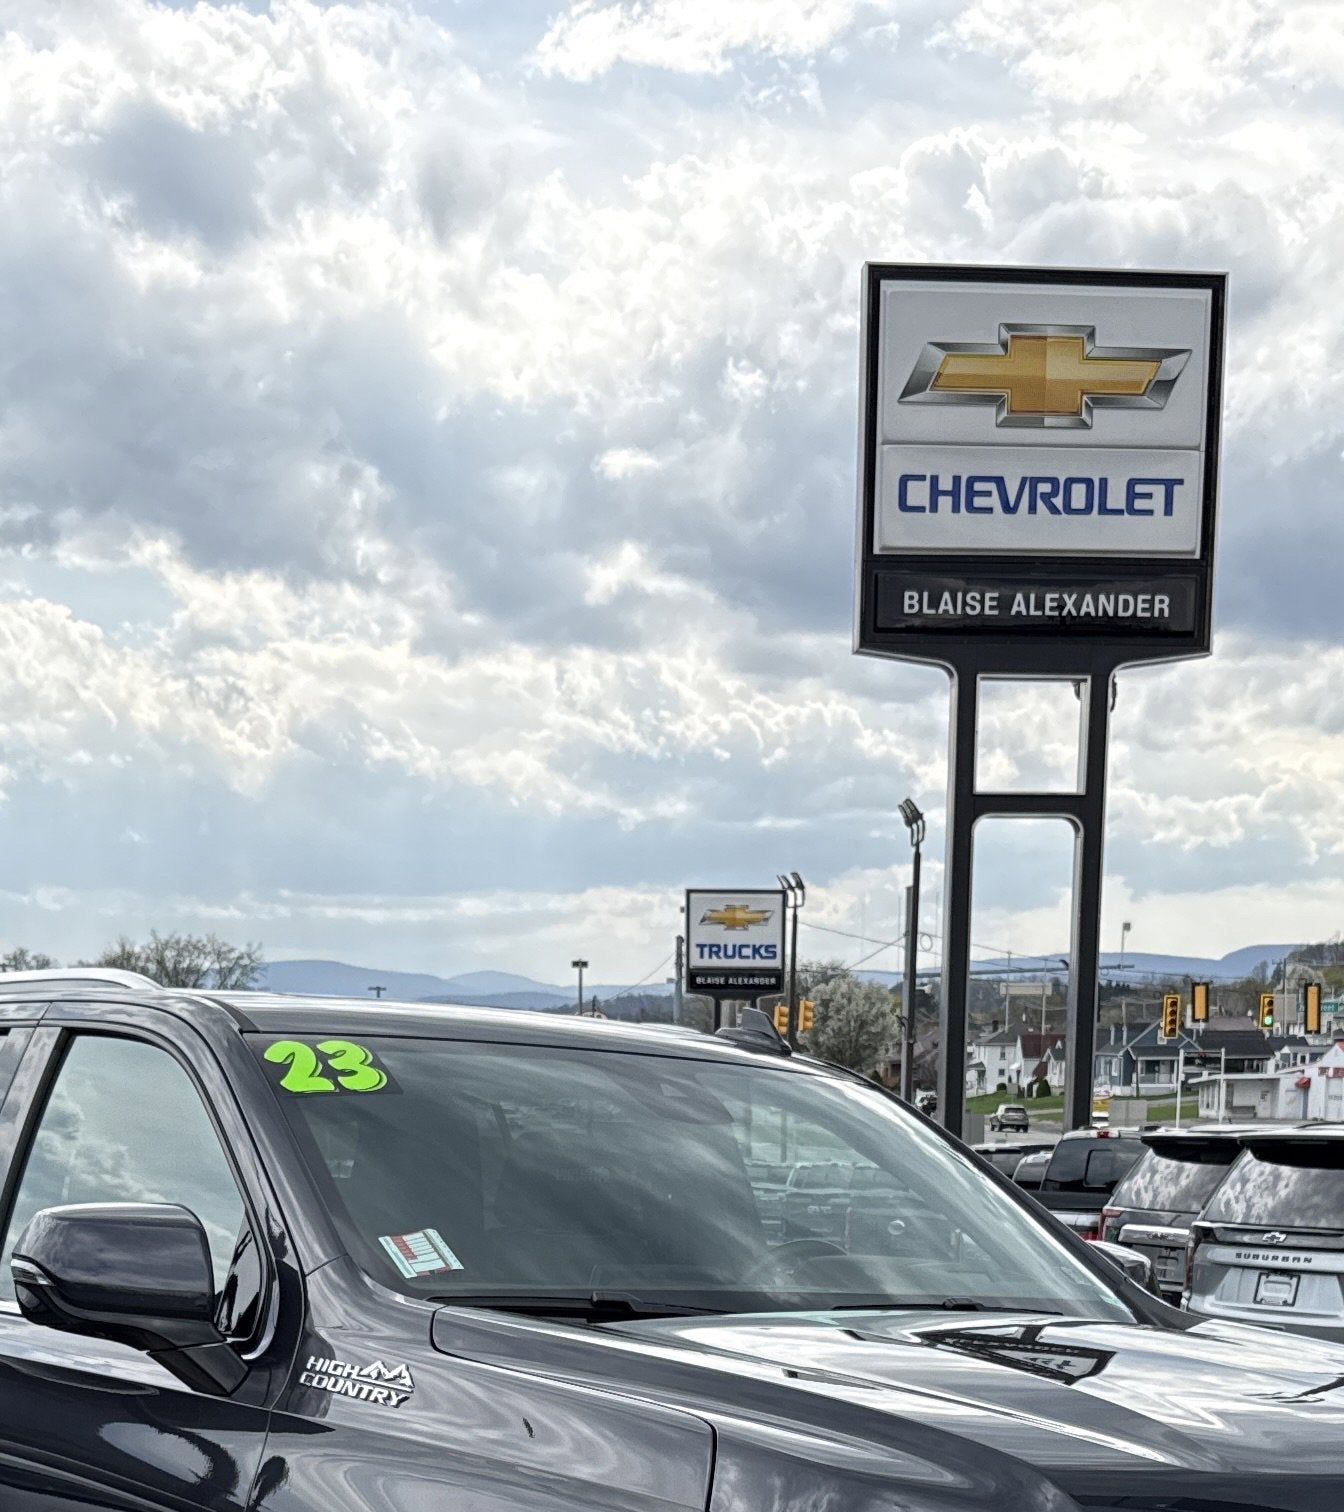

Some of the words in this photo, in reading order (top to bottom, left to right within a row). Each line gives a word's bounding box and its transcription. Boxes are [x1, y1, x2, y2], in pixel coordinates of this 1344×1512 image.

[898, 475, 1184, 516] CHEVROLET
[903, 591, 999, 616] BLAISE
[1010, 592, 1170, 618] ALEXANDER
[696, 944, 777, 960] TRUCKS
[264, 1040, 387, 1093] 23
[1235, 1252, 1312, 1264] SUBURBAN
[306, 1355, 360, 1378] HIGH
[299, 1371, 410, 1408] COUNTRY
